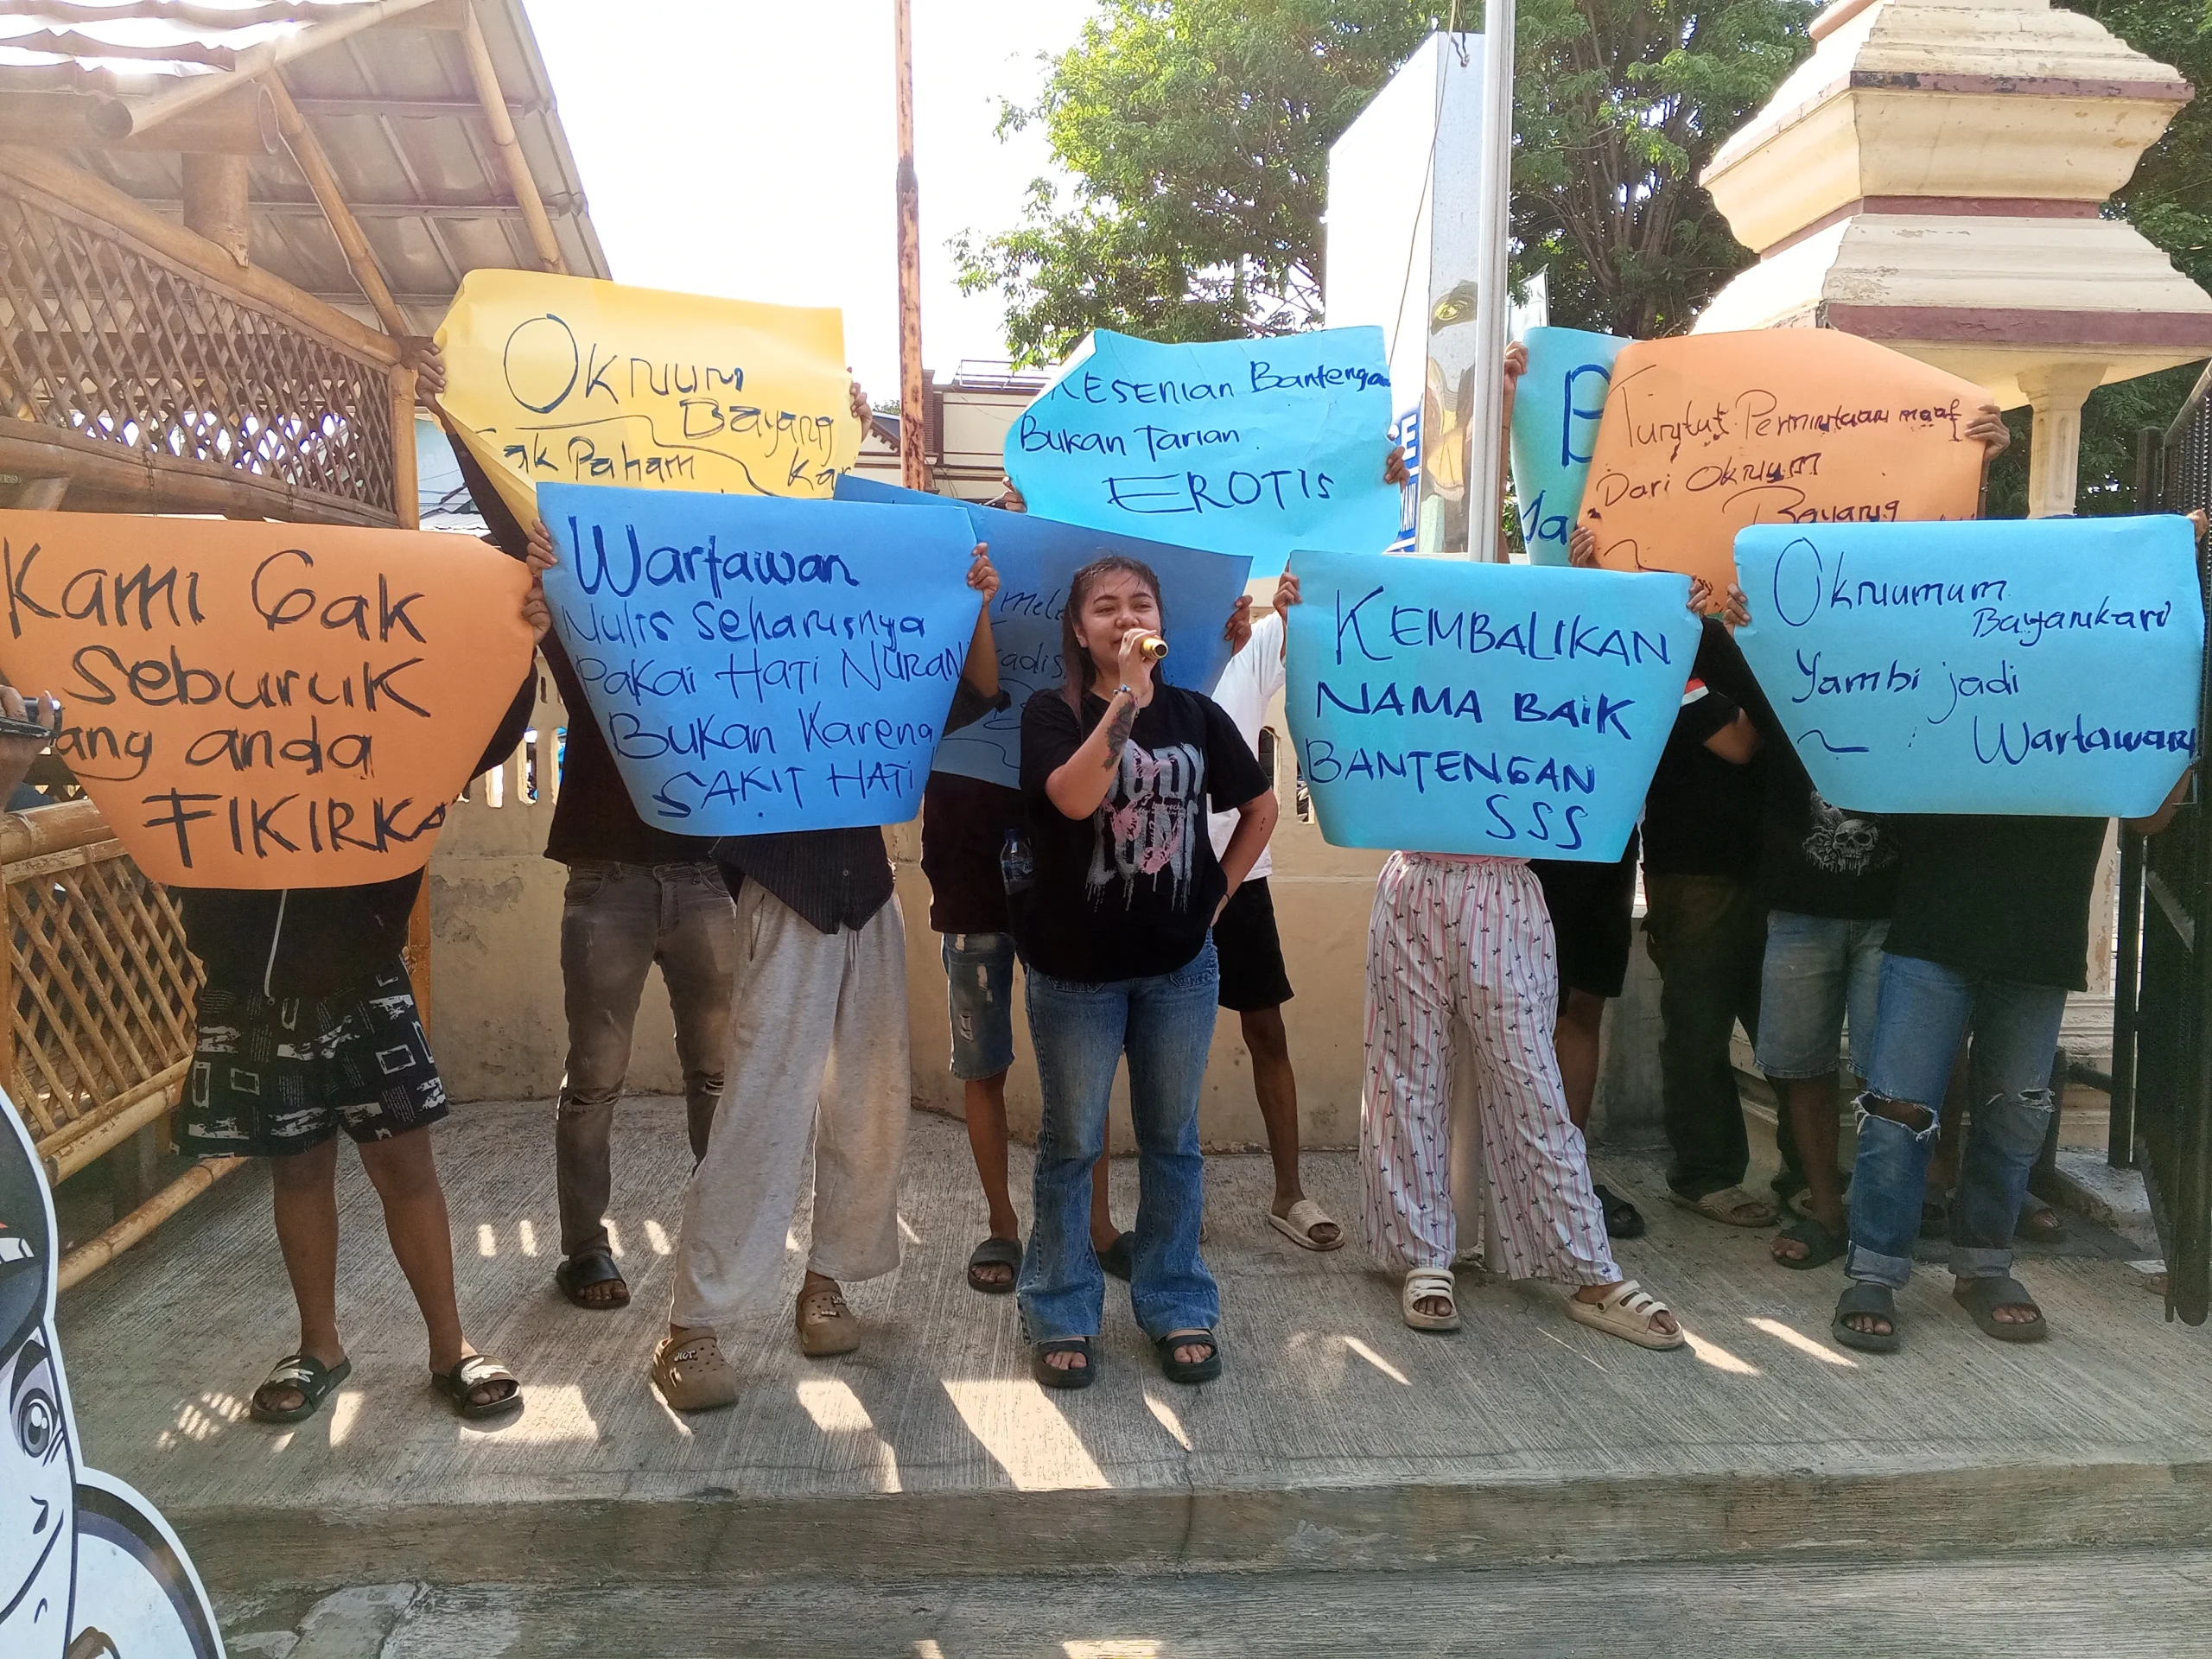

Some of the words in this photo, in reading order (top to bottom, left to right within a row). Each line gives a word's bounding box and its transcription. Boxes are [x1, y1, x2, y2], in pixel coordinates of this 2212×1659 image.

[567, 434, 696, 482] Paham
[1595, 473, 1671, 508] Dari
[567, 513, 861, 601] Wartawan
[1335, 585, 1673, 667] KEMBALIKAN
[1316, 681, 1484, 725] NAMA
[1927, 659, 2020, 725] jadi
[54, 724, 154, 783] ang
[184, 715, 376, 780] anda
[1305, 737, 1597, 795] BANTENGAN
[652, 764, 809, 819] SAKIT
